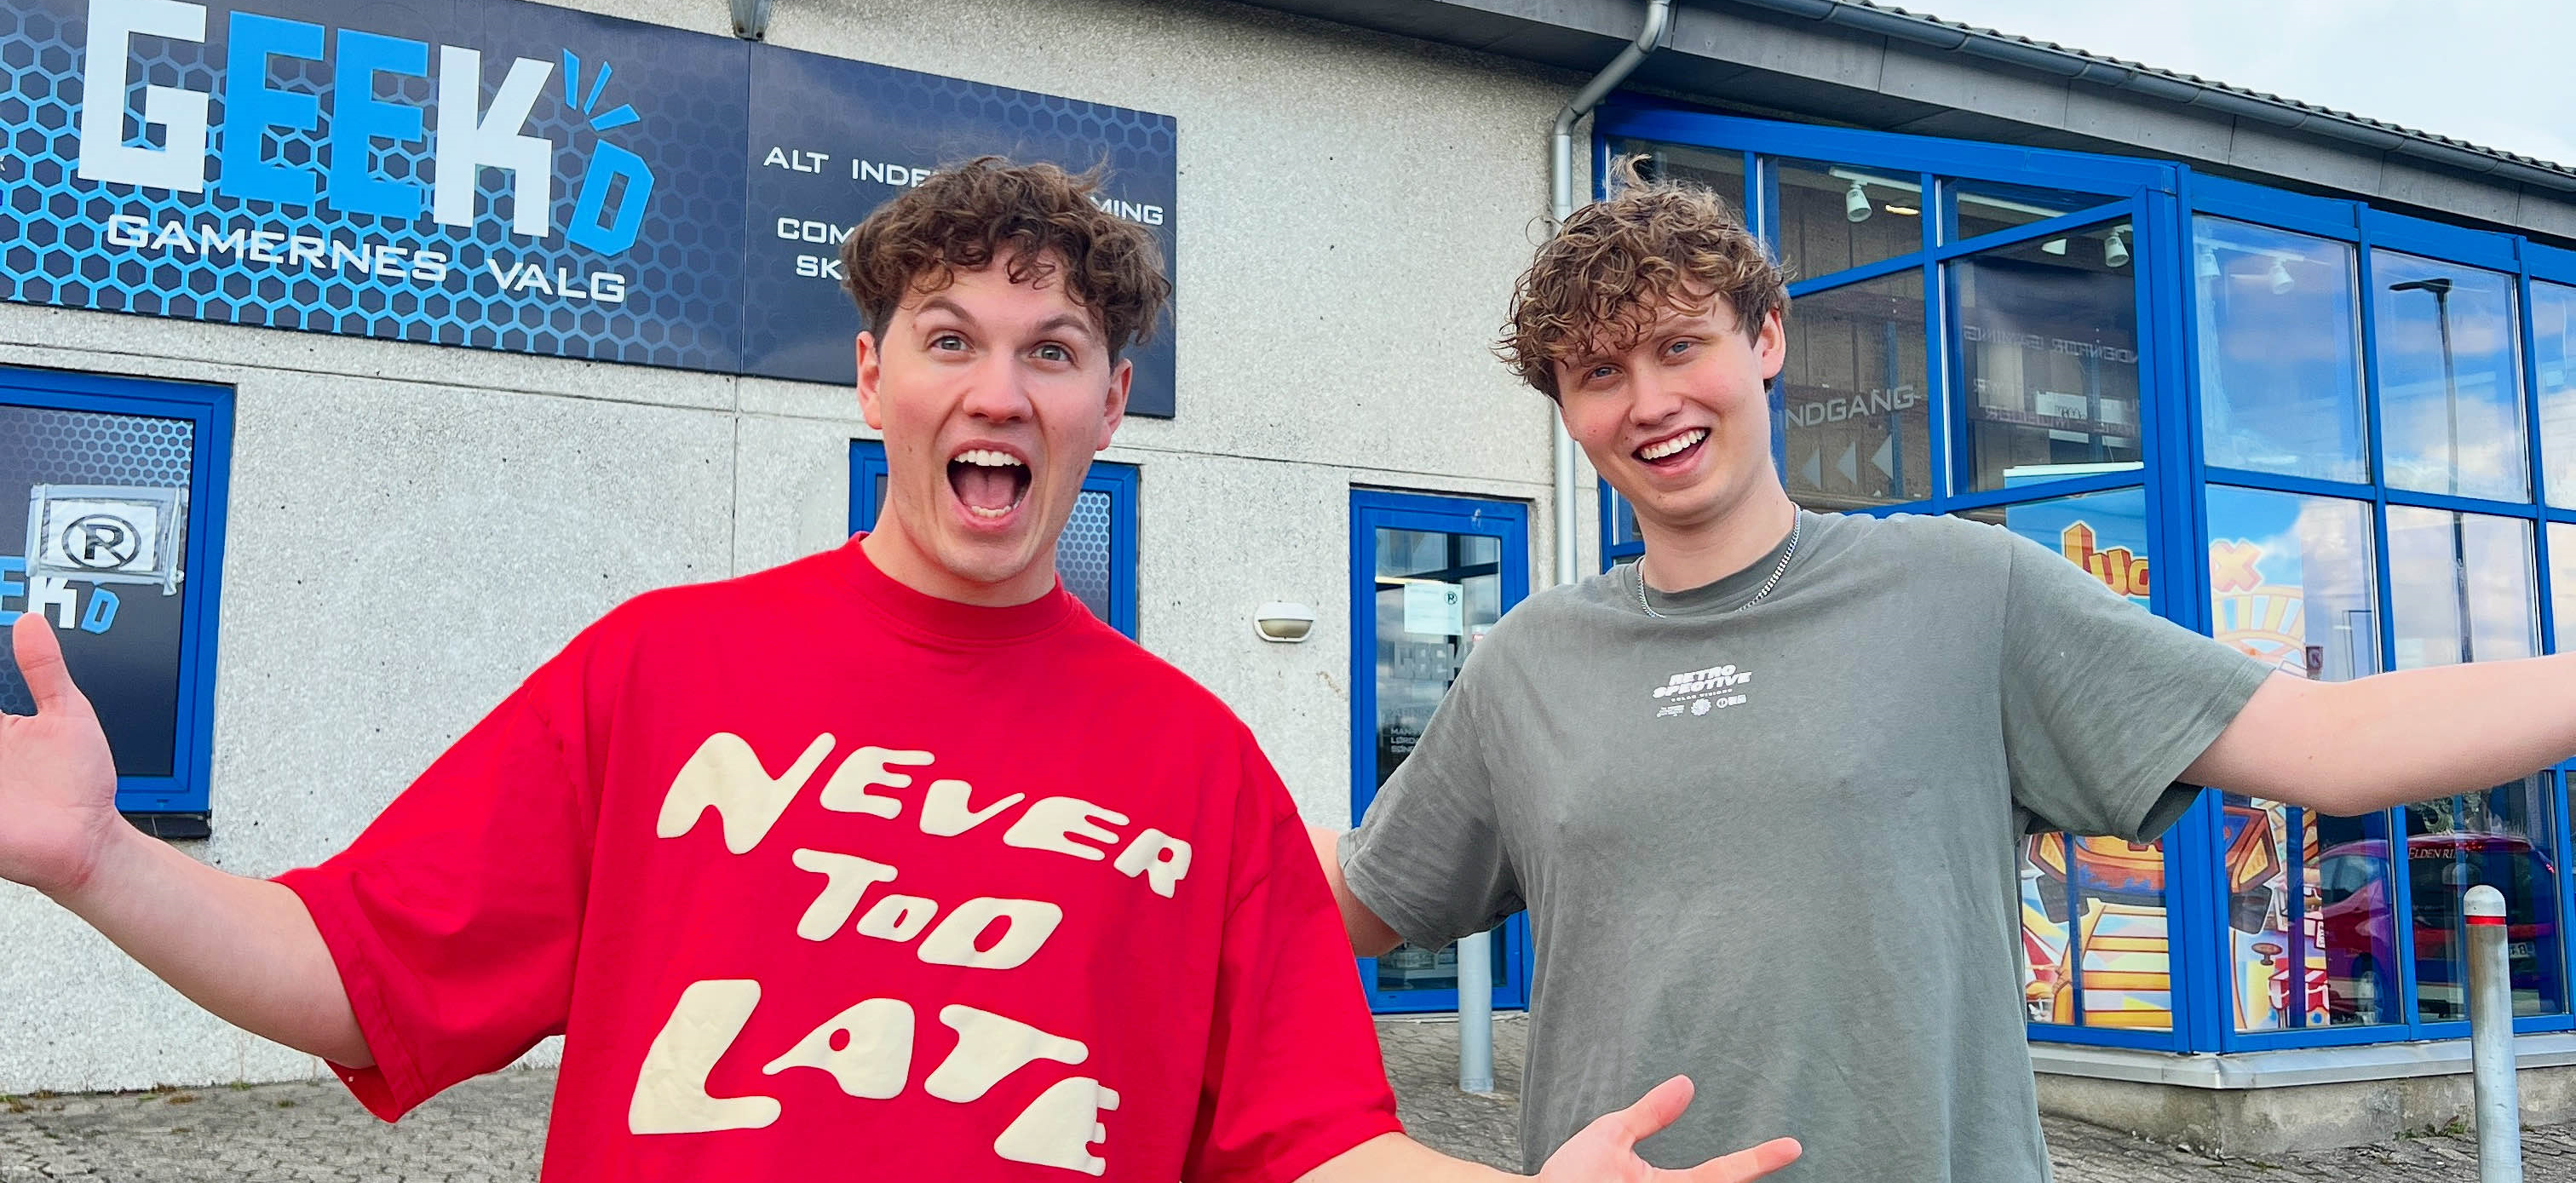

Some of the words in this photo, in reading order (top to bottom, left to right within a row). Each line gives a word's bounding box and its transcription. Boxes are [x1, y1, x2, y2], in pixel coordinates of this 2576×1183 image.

[763, 146, 830, 174] ALT
[107, 214, 447, 282] GAMERNES
[487, 259, 625, 303] VALG
[656, 732, 1193, 899] NEVER
[628, 979, 1120, 1177] LATE
